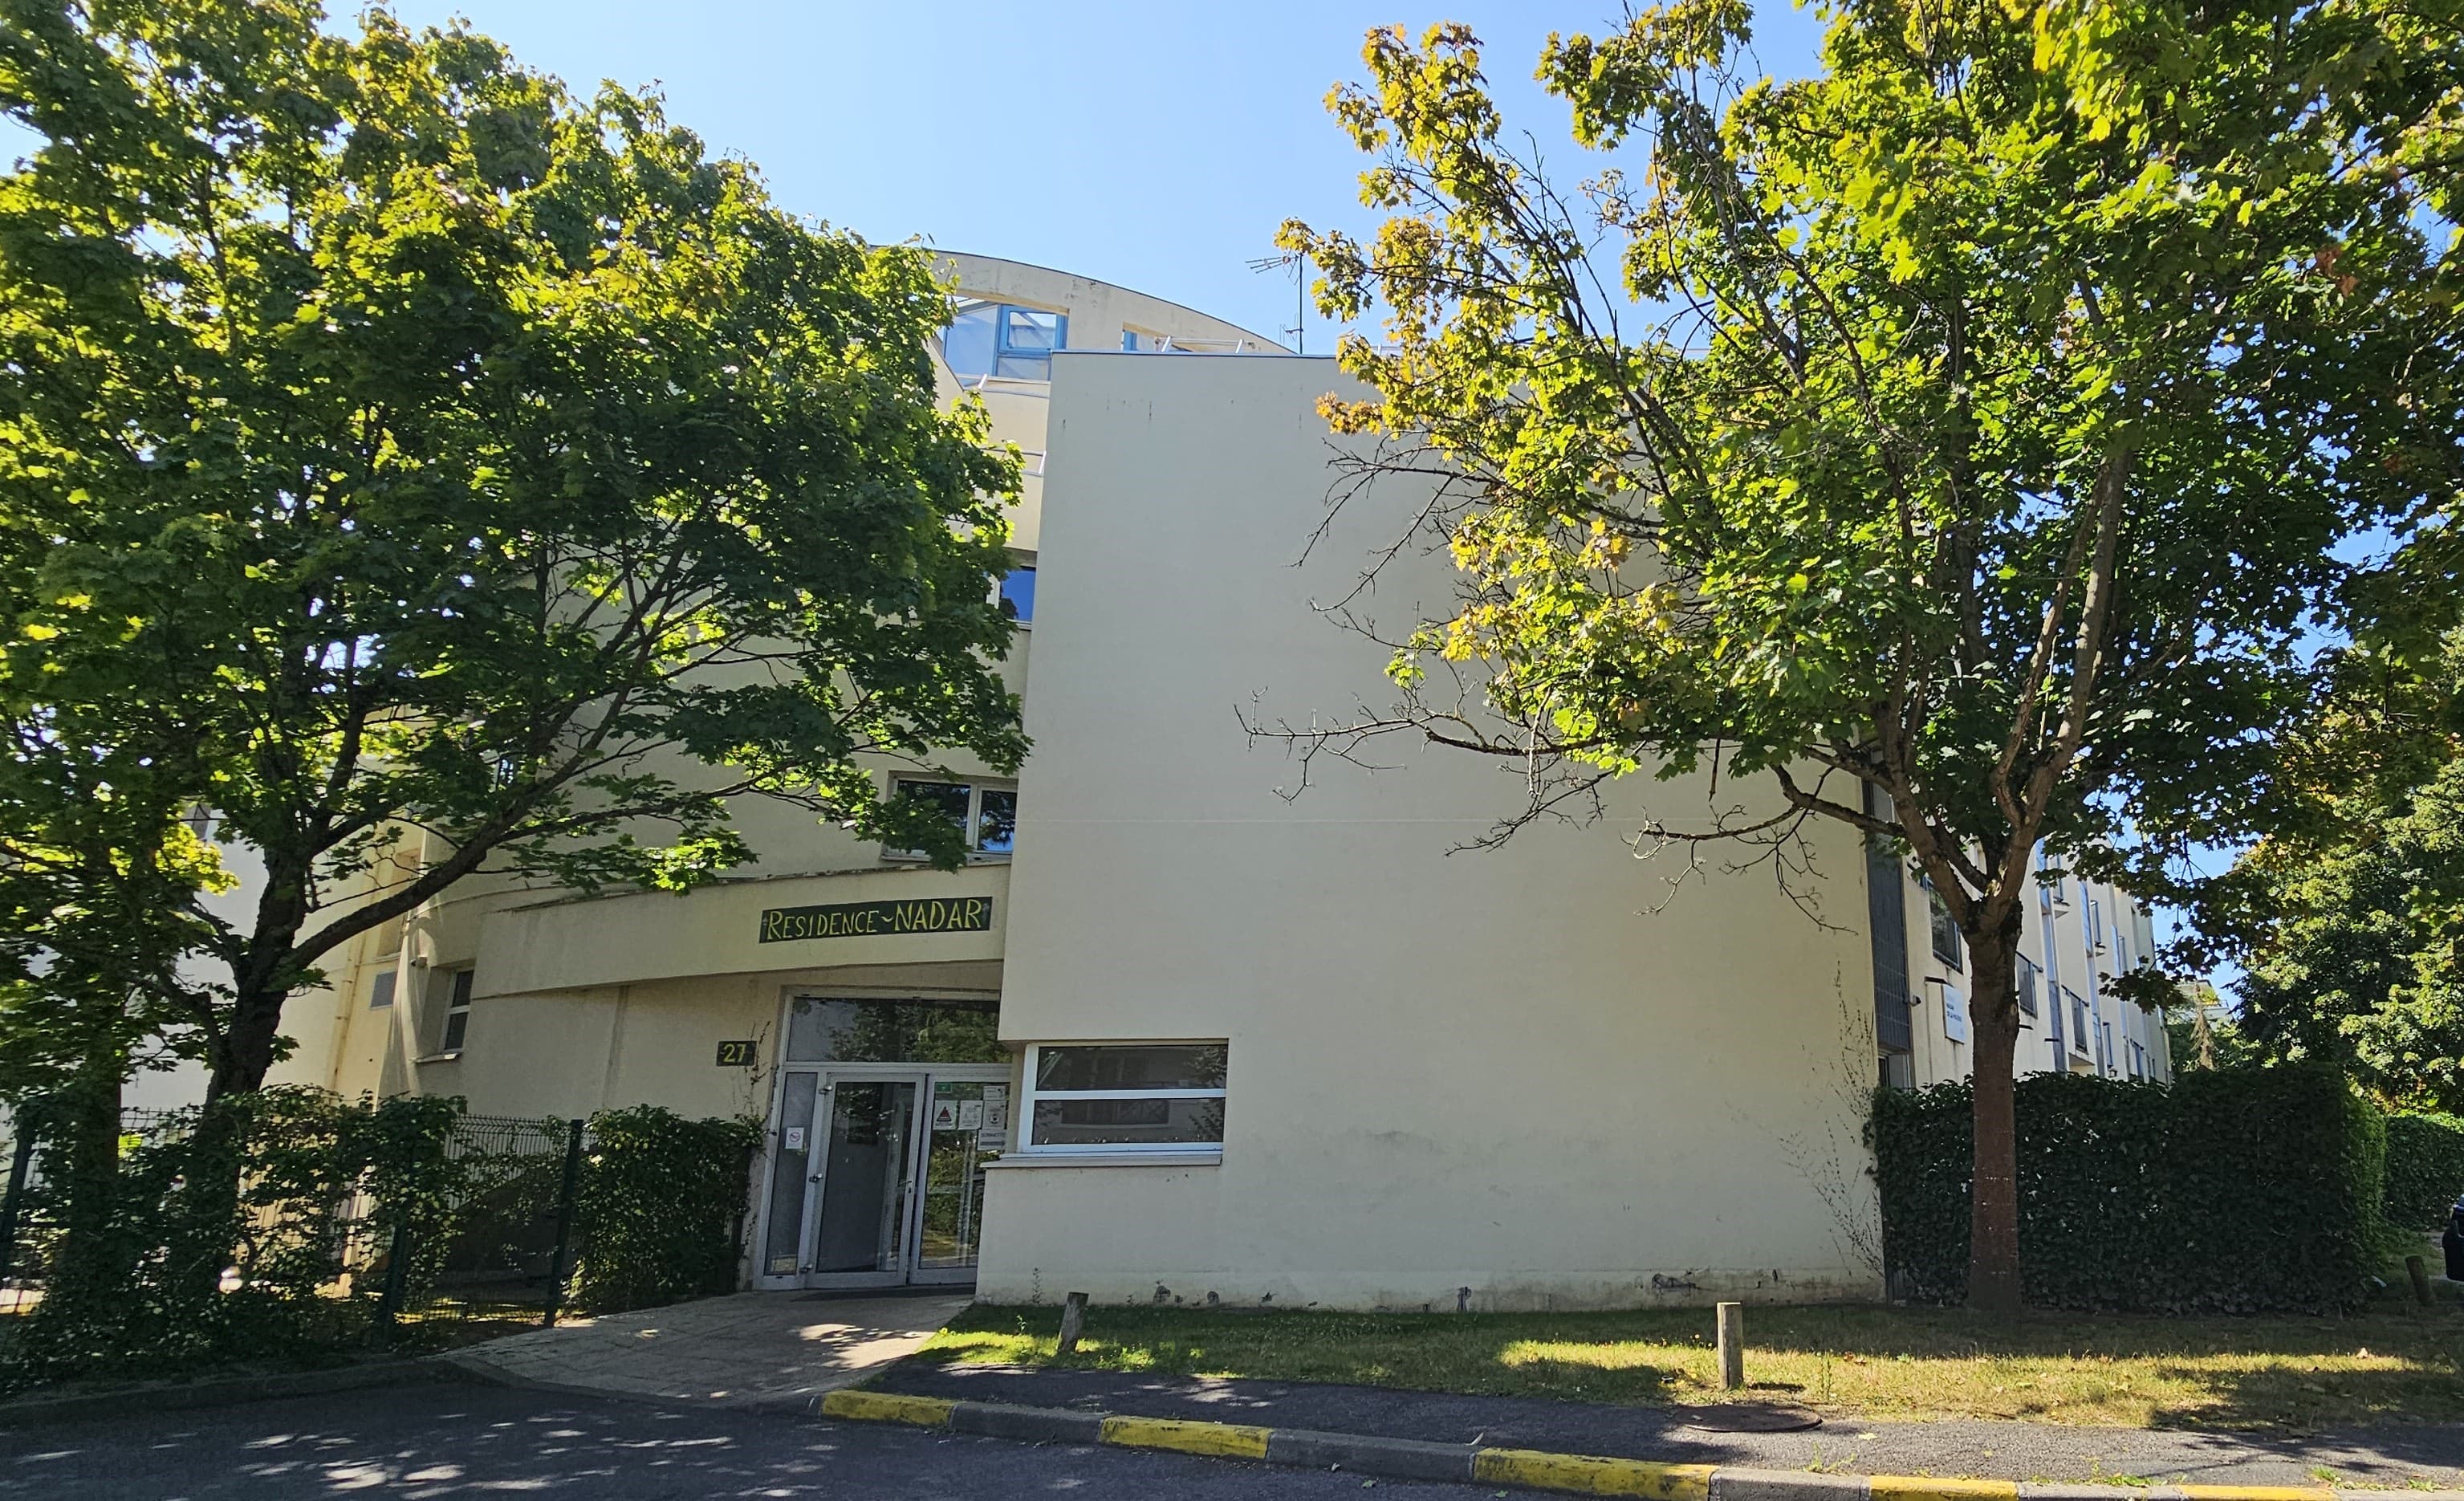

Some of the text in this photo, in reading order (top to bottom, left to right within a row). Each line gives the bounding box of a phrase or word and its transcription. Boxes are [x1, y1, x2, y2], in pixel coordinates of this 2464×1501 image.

[766, 909, 880, 940] RESIDENCE
[894, 898, 982, 932] NADAR
[723, 1043, 746, 1063] 27
